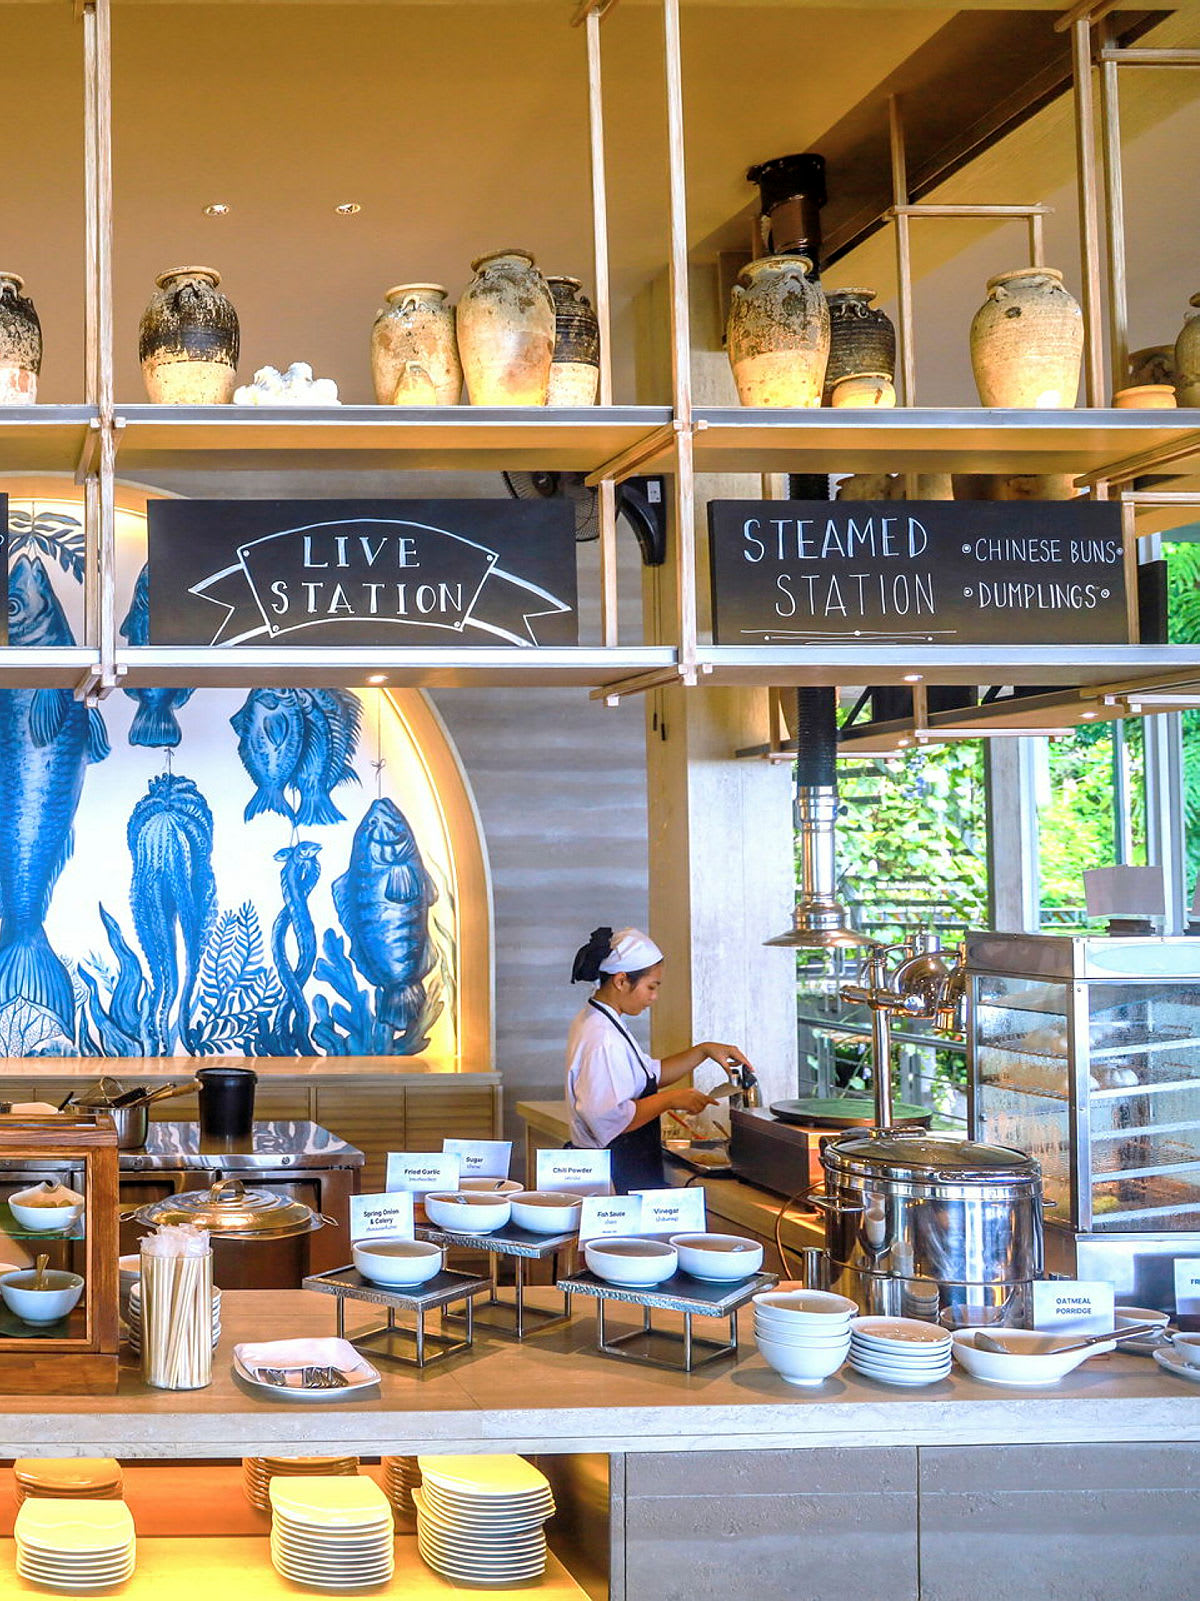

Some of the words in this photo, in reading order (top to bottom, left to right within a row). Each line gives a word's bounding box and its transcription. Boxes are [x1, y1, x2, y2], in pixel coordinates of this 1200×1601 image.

[743, 517, 928, 564] STEAMED
[303, 536, 420, 568] LIVE
[974, 538, 1061, 564] CHINESE
[1071, 539, 1117, 564] BUNS
[270, 581, 463, 615] STATION
[775, 573, 935, 618] STATION
[979, 582, 1097, 609] DUMPLINGS
[465, 1156, 484, 1164] Sugar
[363, 1209, 383, 1218] Spring
[383, 1208, 400, 1216] Onion
[609, 1210, 626, 1218] Sauce
[653, 1207, 680, 1216] Vinegar
[1056, 1297, 1091, 1305] OATMEAL
[1056, 1307, 1092, 1315] PORRIDGE
